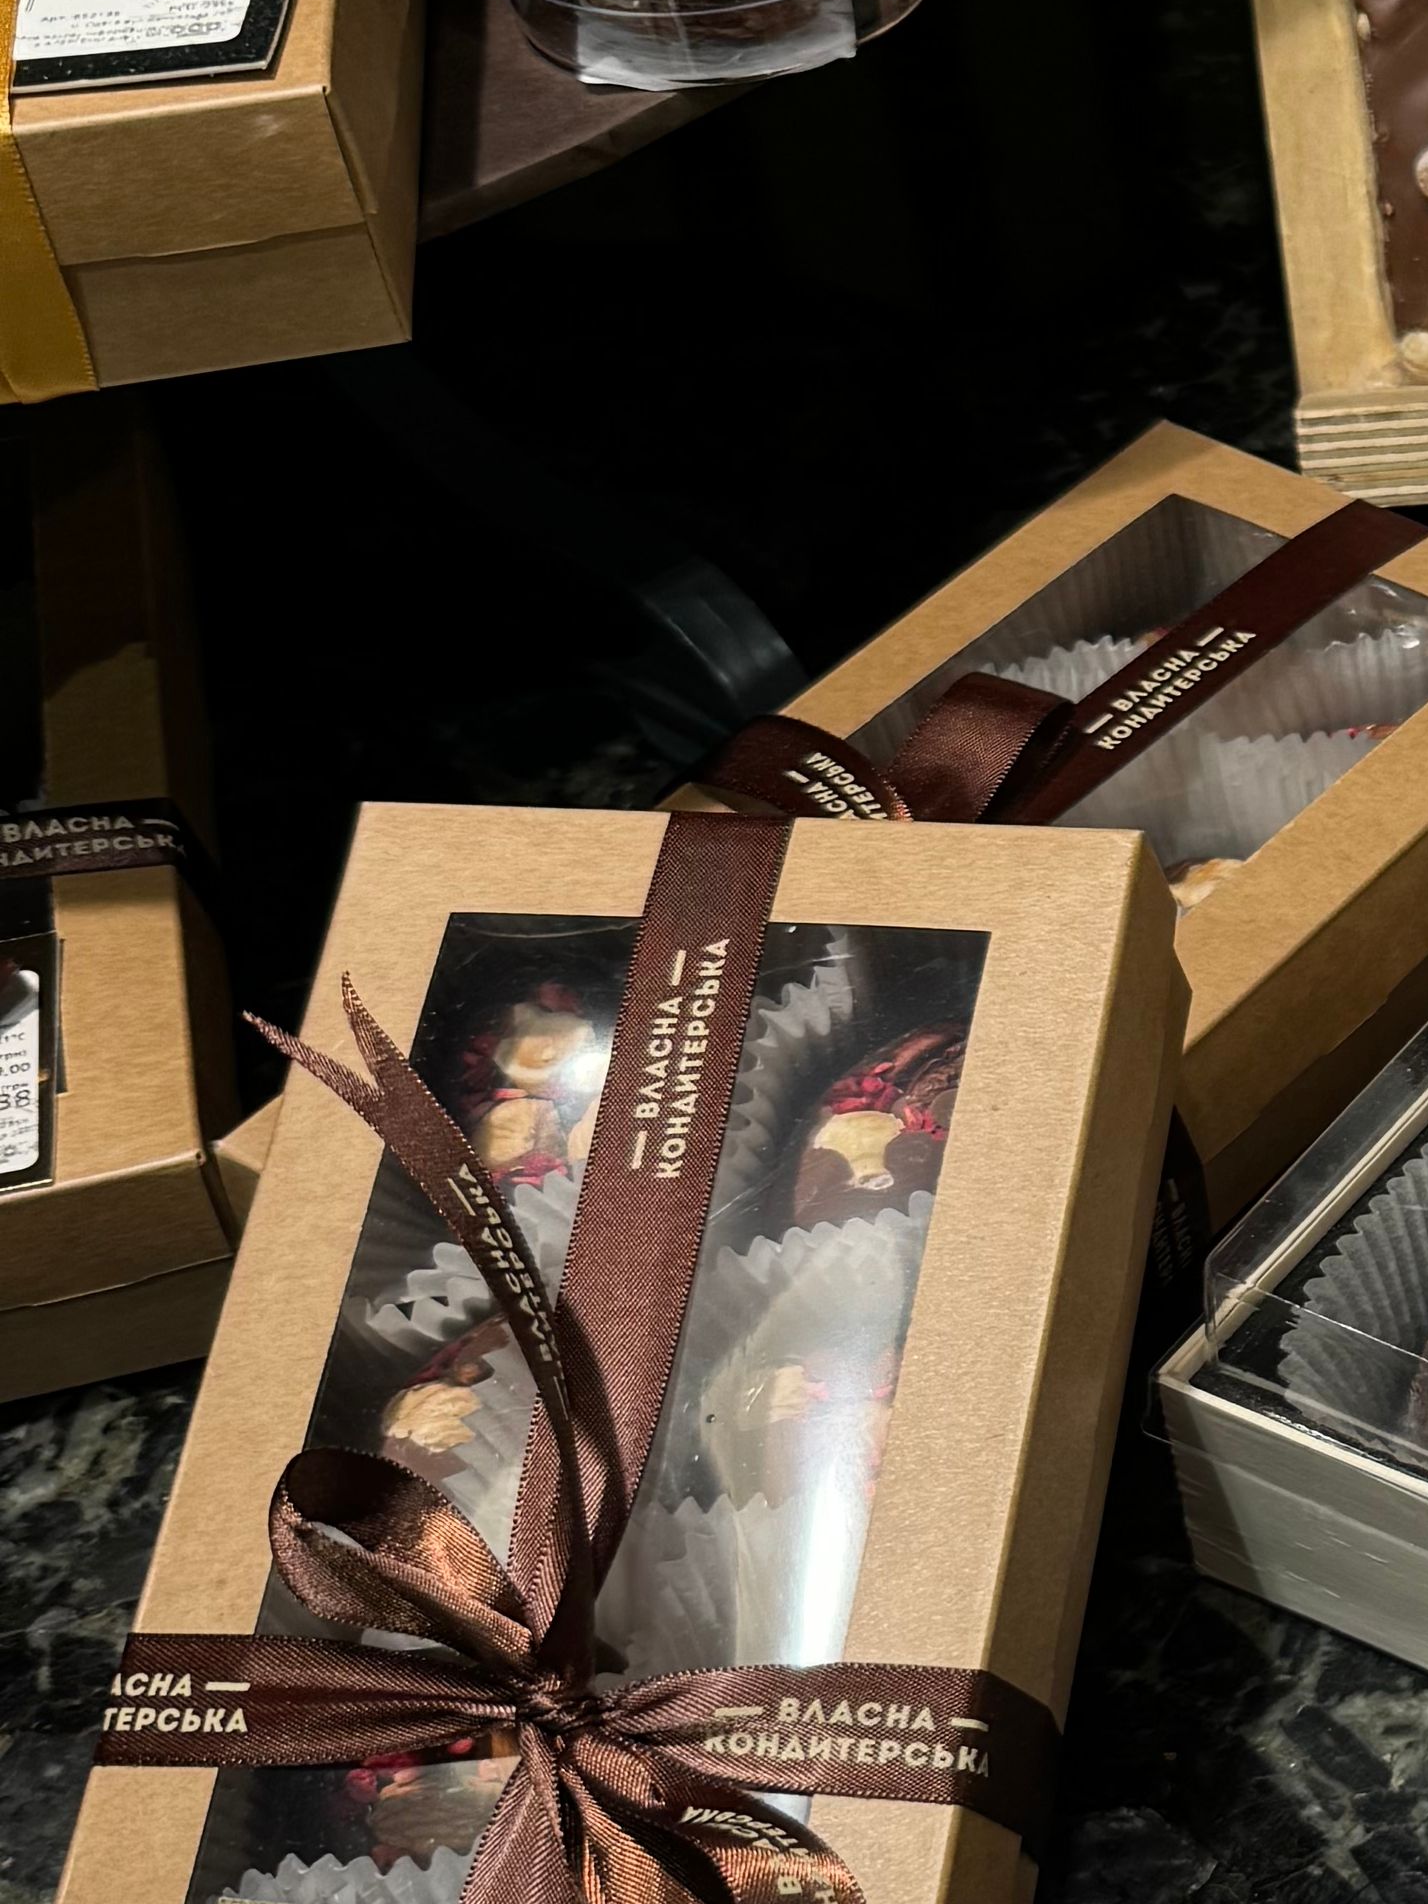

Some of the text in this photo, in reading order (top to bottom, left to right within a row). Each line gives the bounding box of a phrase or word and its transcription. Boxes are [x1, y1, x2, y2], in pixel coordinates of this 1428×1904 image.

[1096, 629, 1257, 751] КОНДИТЕРСЬКА
[1111, 647, 1201, 713] ВЛАСНА
[636, 995, 684, 1120] ВЛАСНА
[656, 938, 731, 1180] КОНДИТЕРСЬКА
[701, 1731, 990, 1778] КОНДИТЕРСЬКА
[776, 1697, 937, 1732] ВЛАСНА
